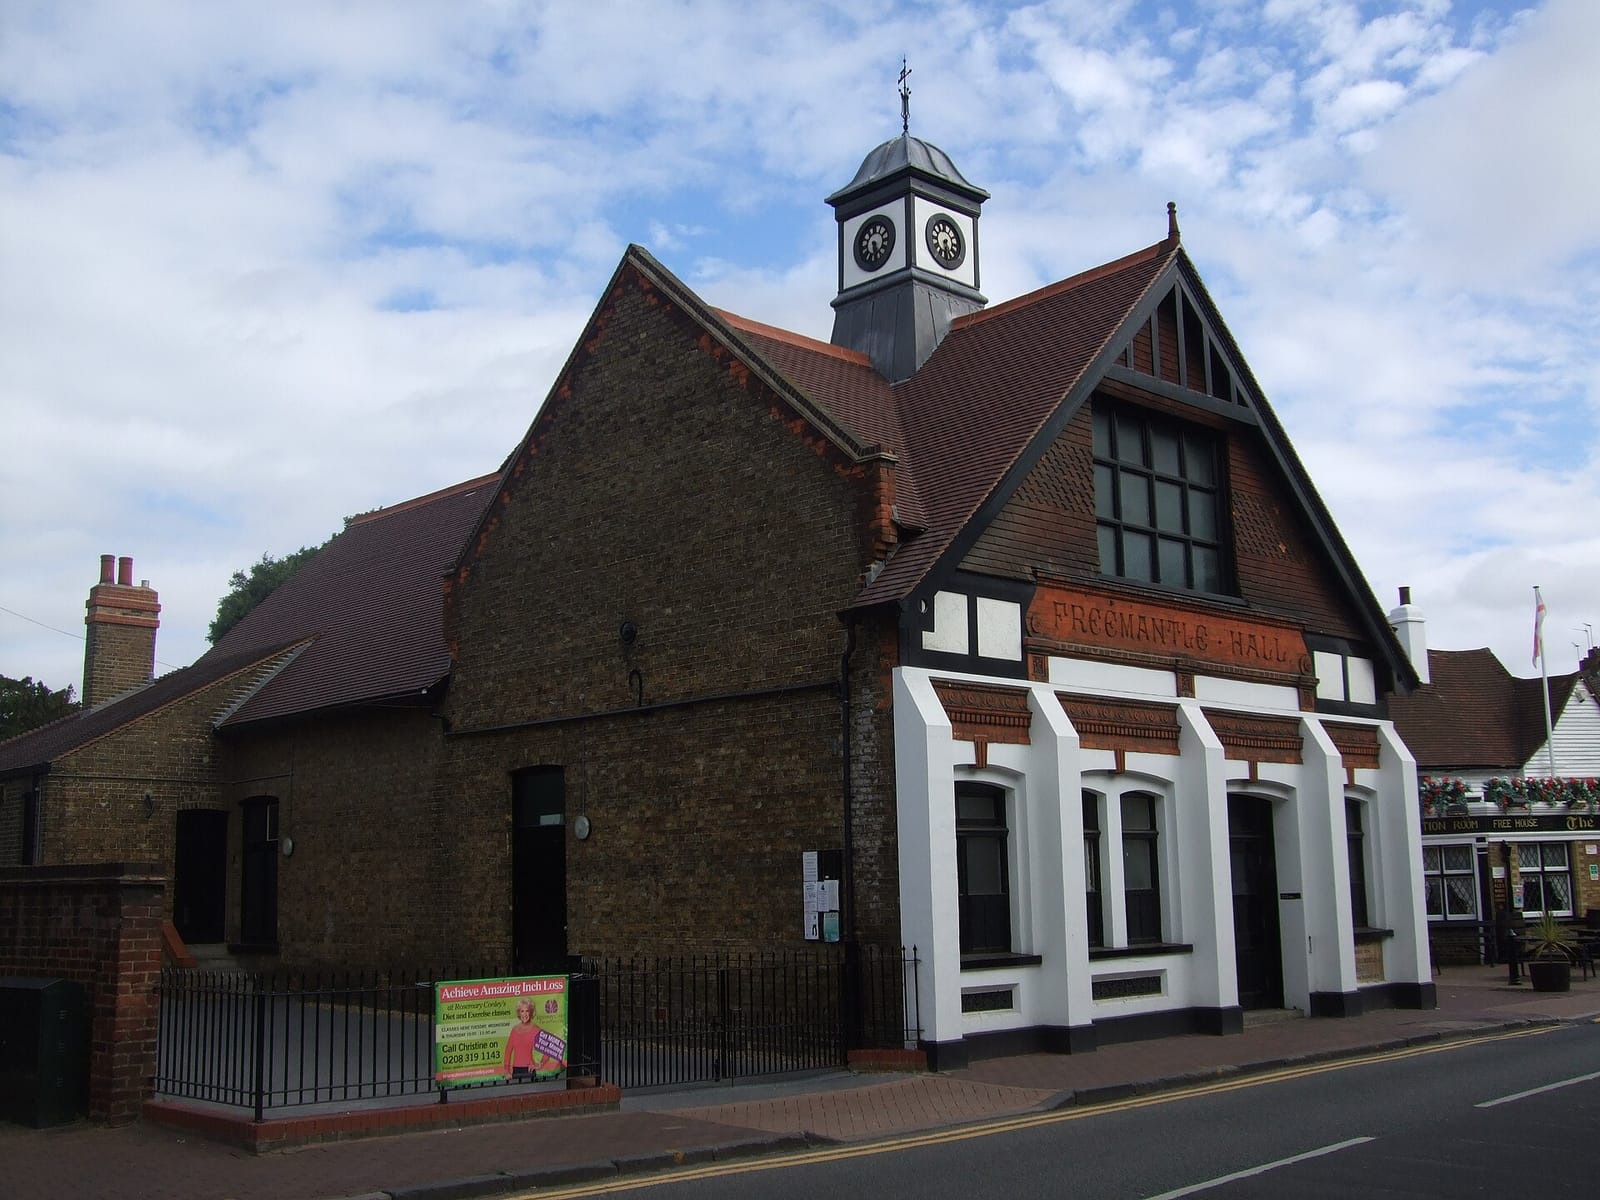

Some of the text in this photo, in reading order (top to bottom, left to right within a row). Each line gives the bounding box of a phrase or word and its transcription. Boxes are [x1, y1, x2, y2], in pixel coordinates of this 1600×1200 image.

[1053, 600, 1287, 662] FREEMANTLE HALL
[1453, 819, 1479, 830] ROOM
[1493, 818, 1538, 828] FREE HOUSE
[1566, 815, 1594, 830] The
[442, 980, 564, 999] Achieve Amazing Inch Loss
[442, 1041, 499, 1053] Call Christine on
[442, 1051, 500, 1064] 0208 319 1143
